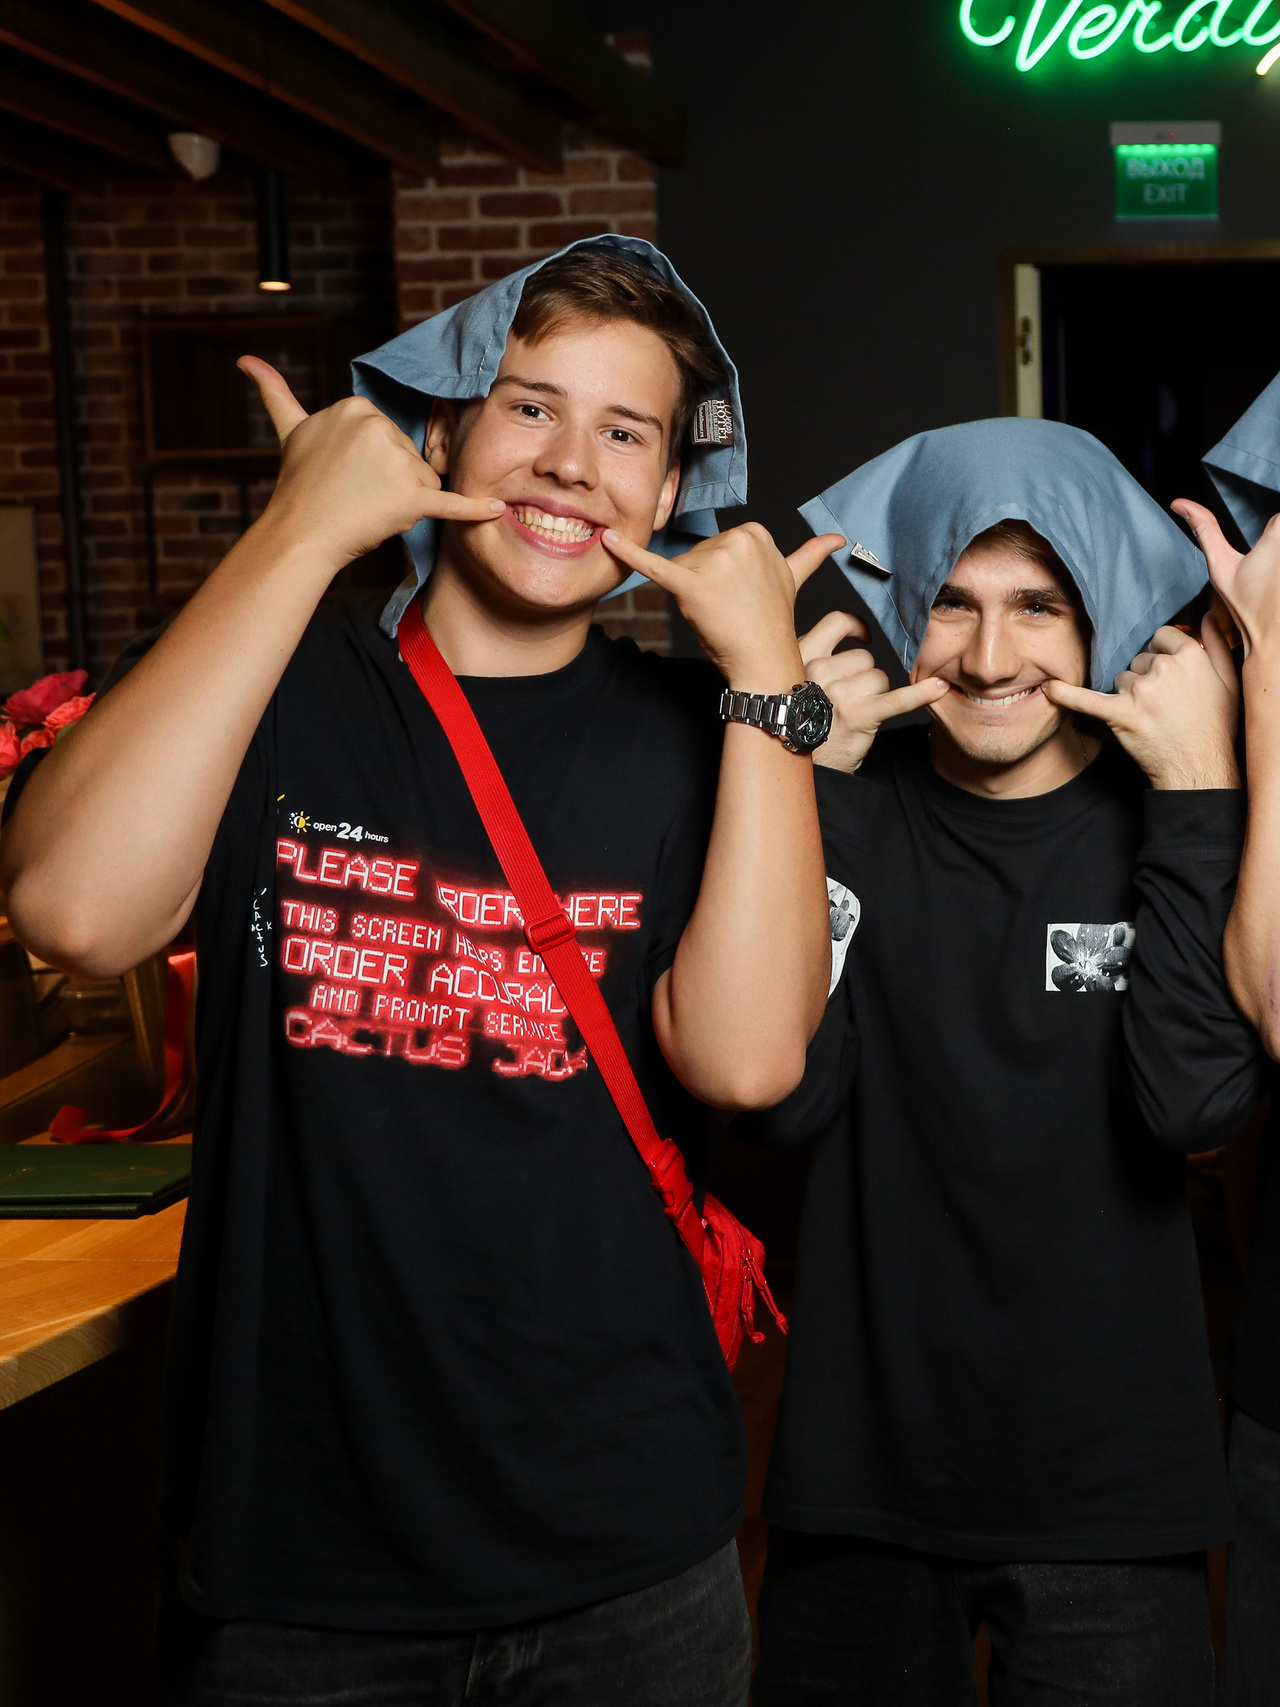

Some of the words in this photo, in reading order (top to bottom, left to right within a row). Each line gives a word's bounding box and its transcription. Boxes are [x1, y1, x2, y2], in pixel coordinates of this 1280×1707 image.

[1126, 157, 1207, 180] ВЫХОД
[1143, 183, 1189, 205] EXIT
[312, 821, 338, 832] open
[336, 822, 363, 842] 24
[364, 831, 389, 843] hours
[277, 841, 417, 897] PLEASE
[437, 886, 525, 926] RDER
[283, 901, 338, 933] THIS
[351, 914, 442, 951] SCREEN
[455, 932, 503, 973] HELPS
[284, 937, 409, 987] ORDER
[285, 1010, 467, 1065] CACTUS
[312, 984, 360, 1013] AND
[374, 994, 472, 1031] PROMPT
[486, 1011, 564, 1042] SERVICE
